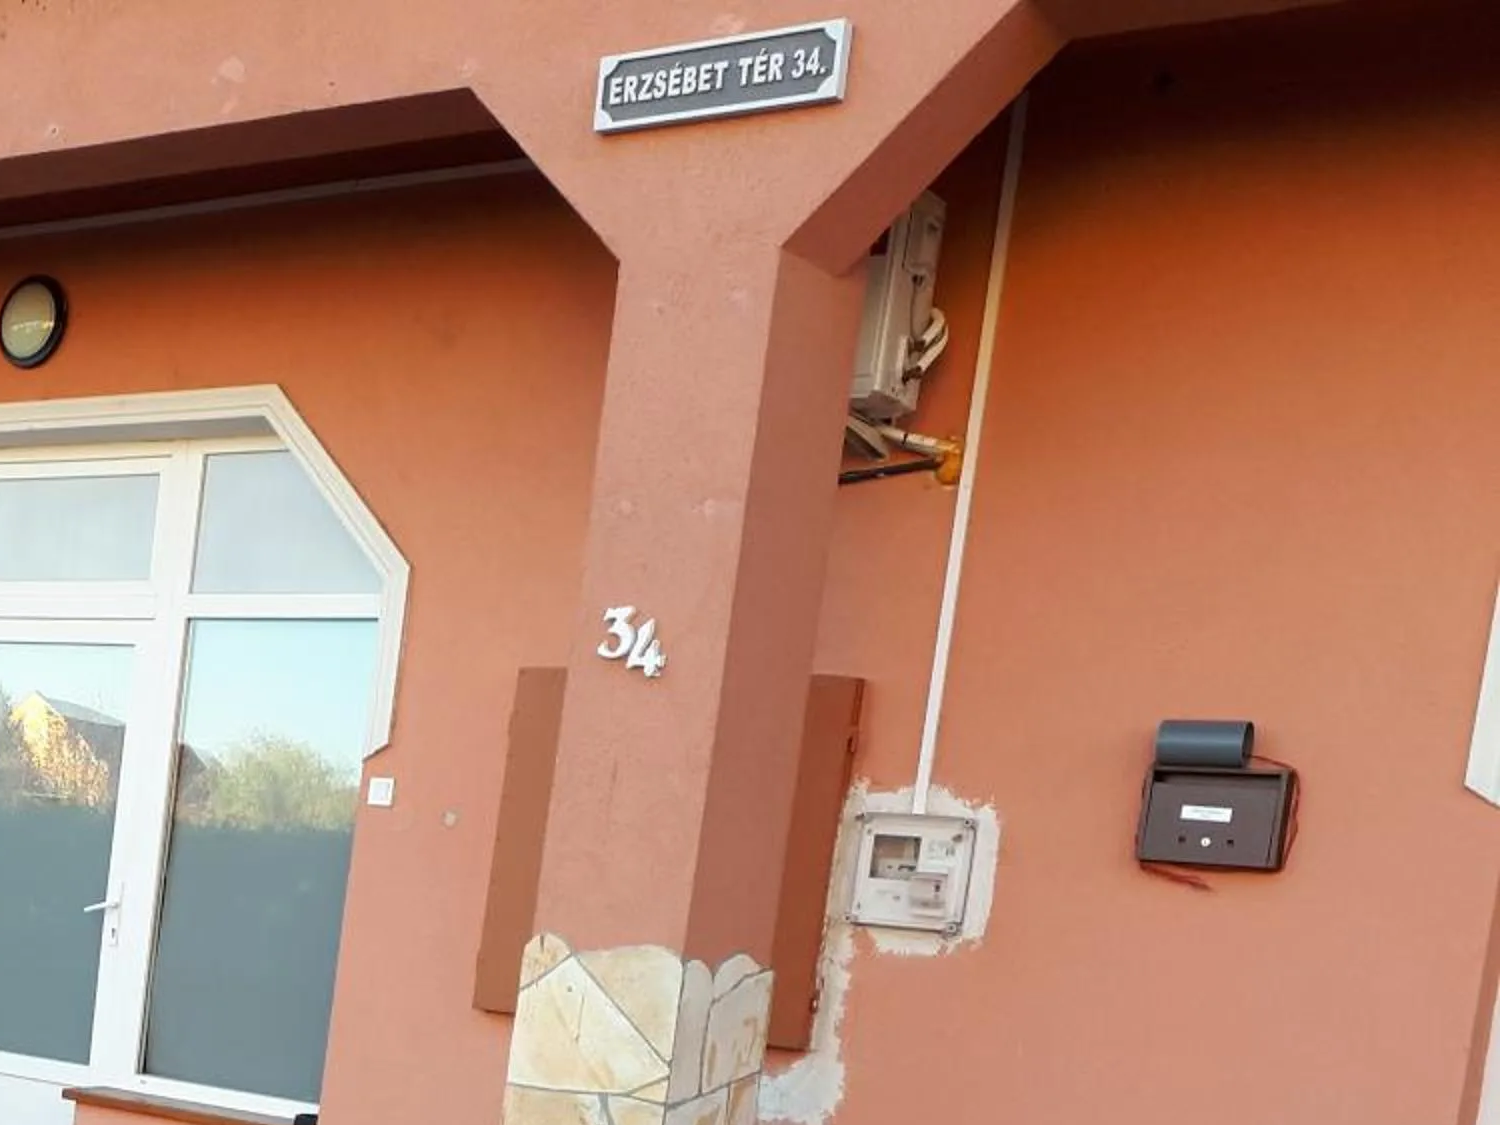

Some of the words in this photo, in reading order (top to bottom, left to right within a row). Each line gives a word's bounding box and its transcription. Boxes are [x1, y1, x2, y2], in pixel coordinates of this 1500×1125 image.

[609, 60, 729, 105] ERZSÉBET
[738, 47, 784, 88] TÉR
[791, 46, 826, 79] 34.
[597, 605, 666, 677] 34
